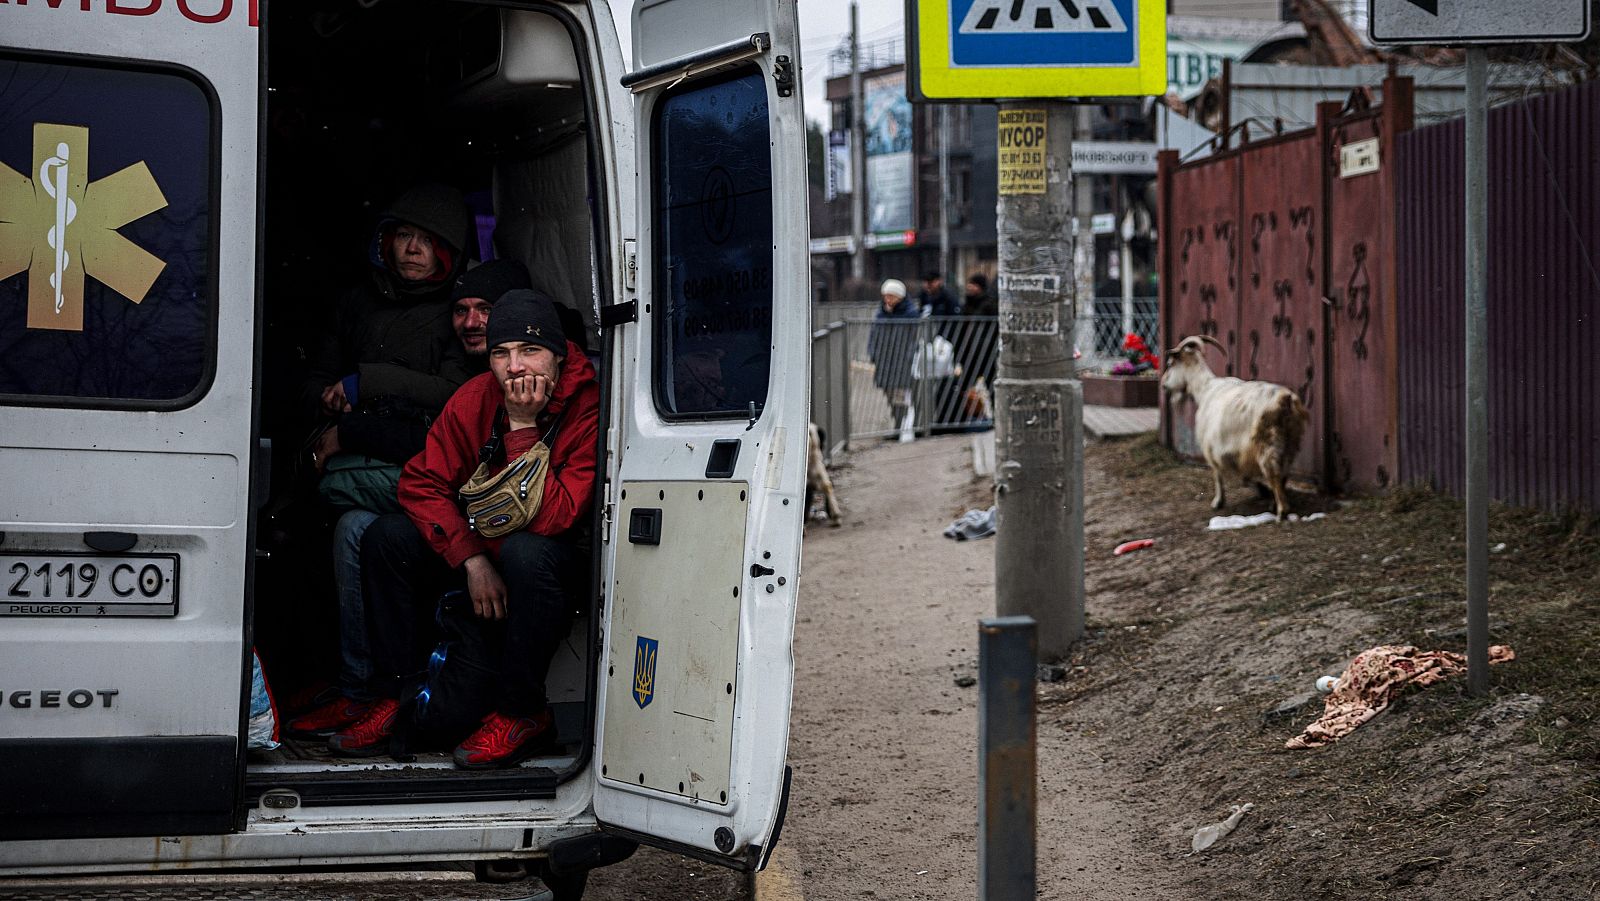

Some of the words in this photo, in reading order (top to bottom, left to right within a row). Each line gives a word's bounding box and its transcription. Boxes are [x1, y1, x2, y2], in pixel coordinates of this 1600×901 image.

[8, 562, 99, 597] 2119
[9, 605, 82, 614] PEUGEOT
[0, 689, 119, 708] GEOT
